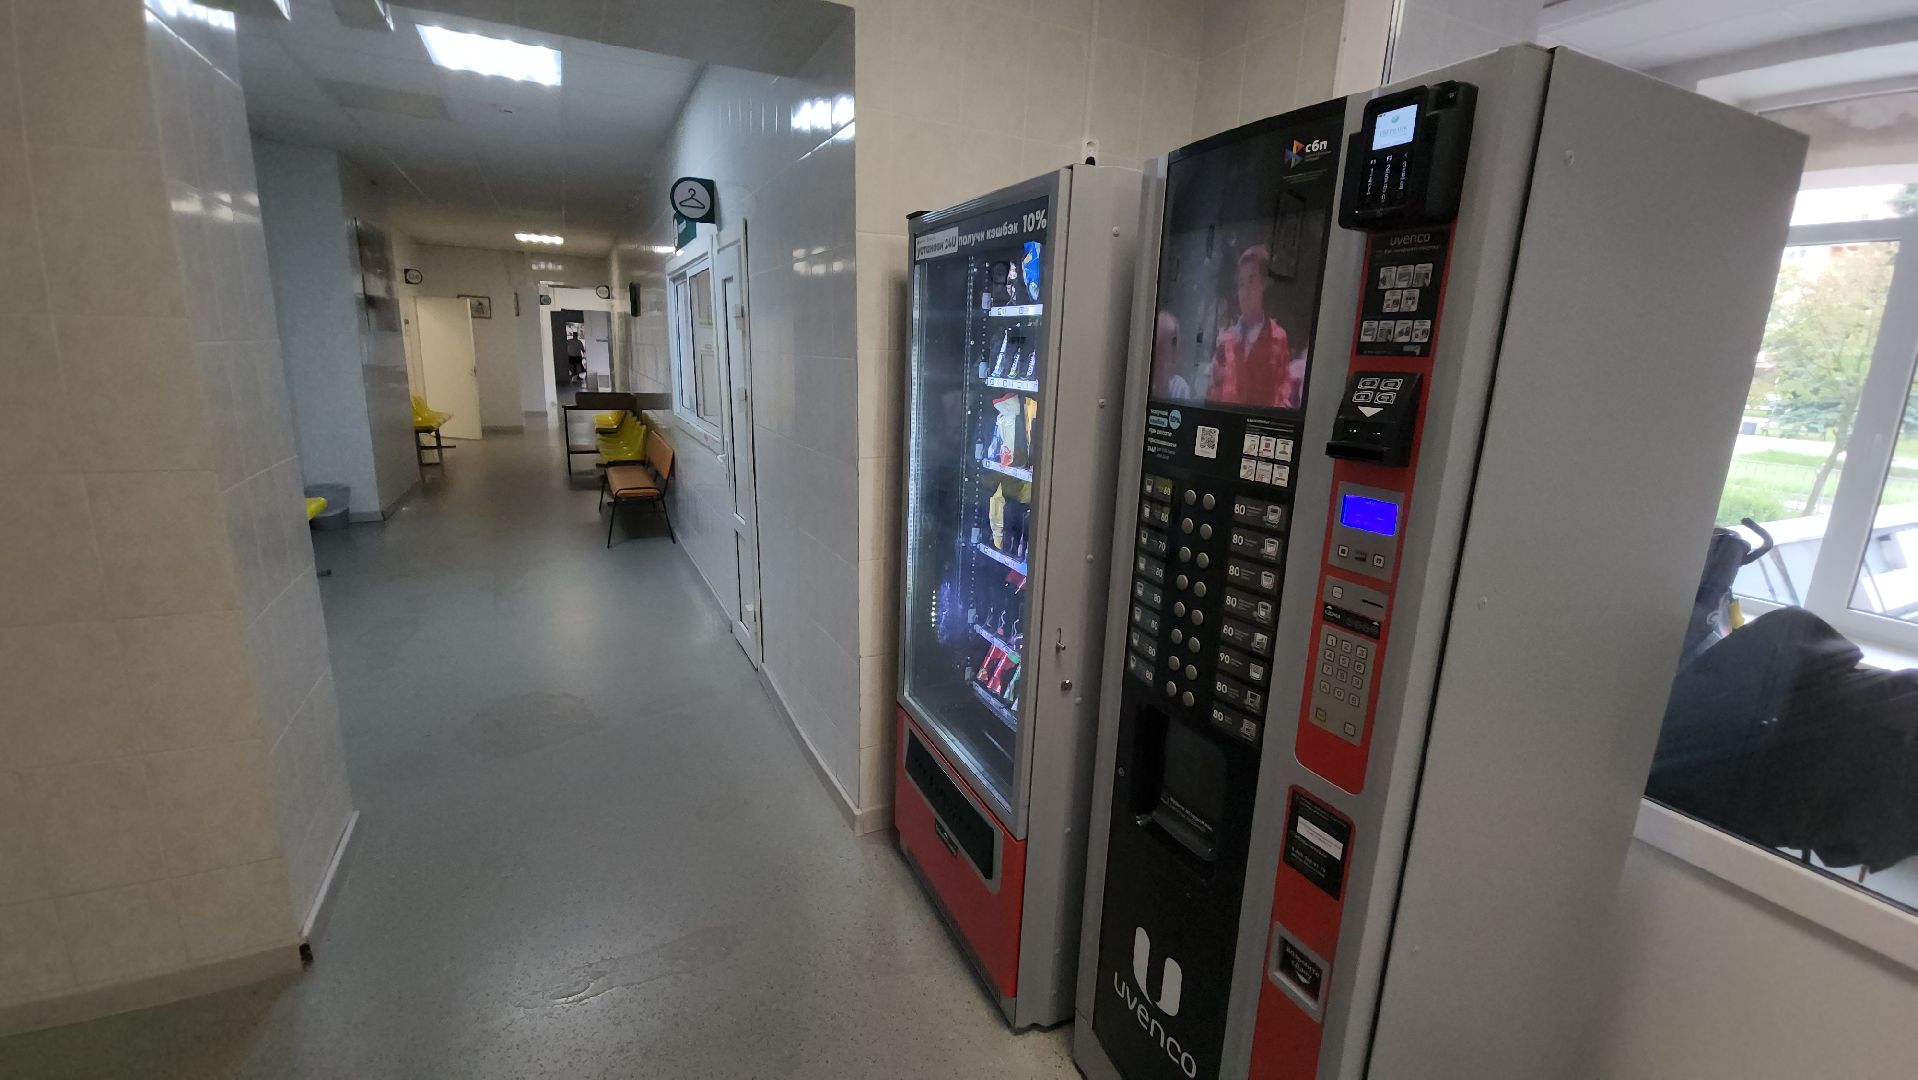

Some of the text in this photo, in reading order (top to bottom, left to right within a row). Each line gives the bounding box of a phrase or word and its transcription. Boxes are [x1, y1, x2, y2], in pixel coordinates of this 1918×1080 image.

[958, 234, 985, 247] получи
[986, 221, 1019, 239] кэшбэк
[1022, 209, 1047, 233] 10%
[1390, 233, 1431, 247] uvenco
[1234, 503, 1246, 516] 80
[1160, 512, 1169, 523] 80
[1158, 540, 1166, 552] 70
[1232, 533, 1244, 547] 80
[1228, 565, 1240, 578] 80
[1225, 595, 1238, 609] 80
[1222, 624, 1234, 638] 80
[1218, 652, 1231, 665] 90
[1215, 681, 1228, 695] 80
[1212, 708, 1224, 723] 80
[1113, 970, 1198, 1079] uvenco
